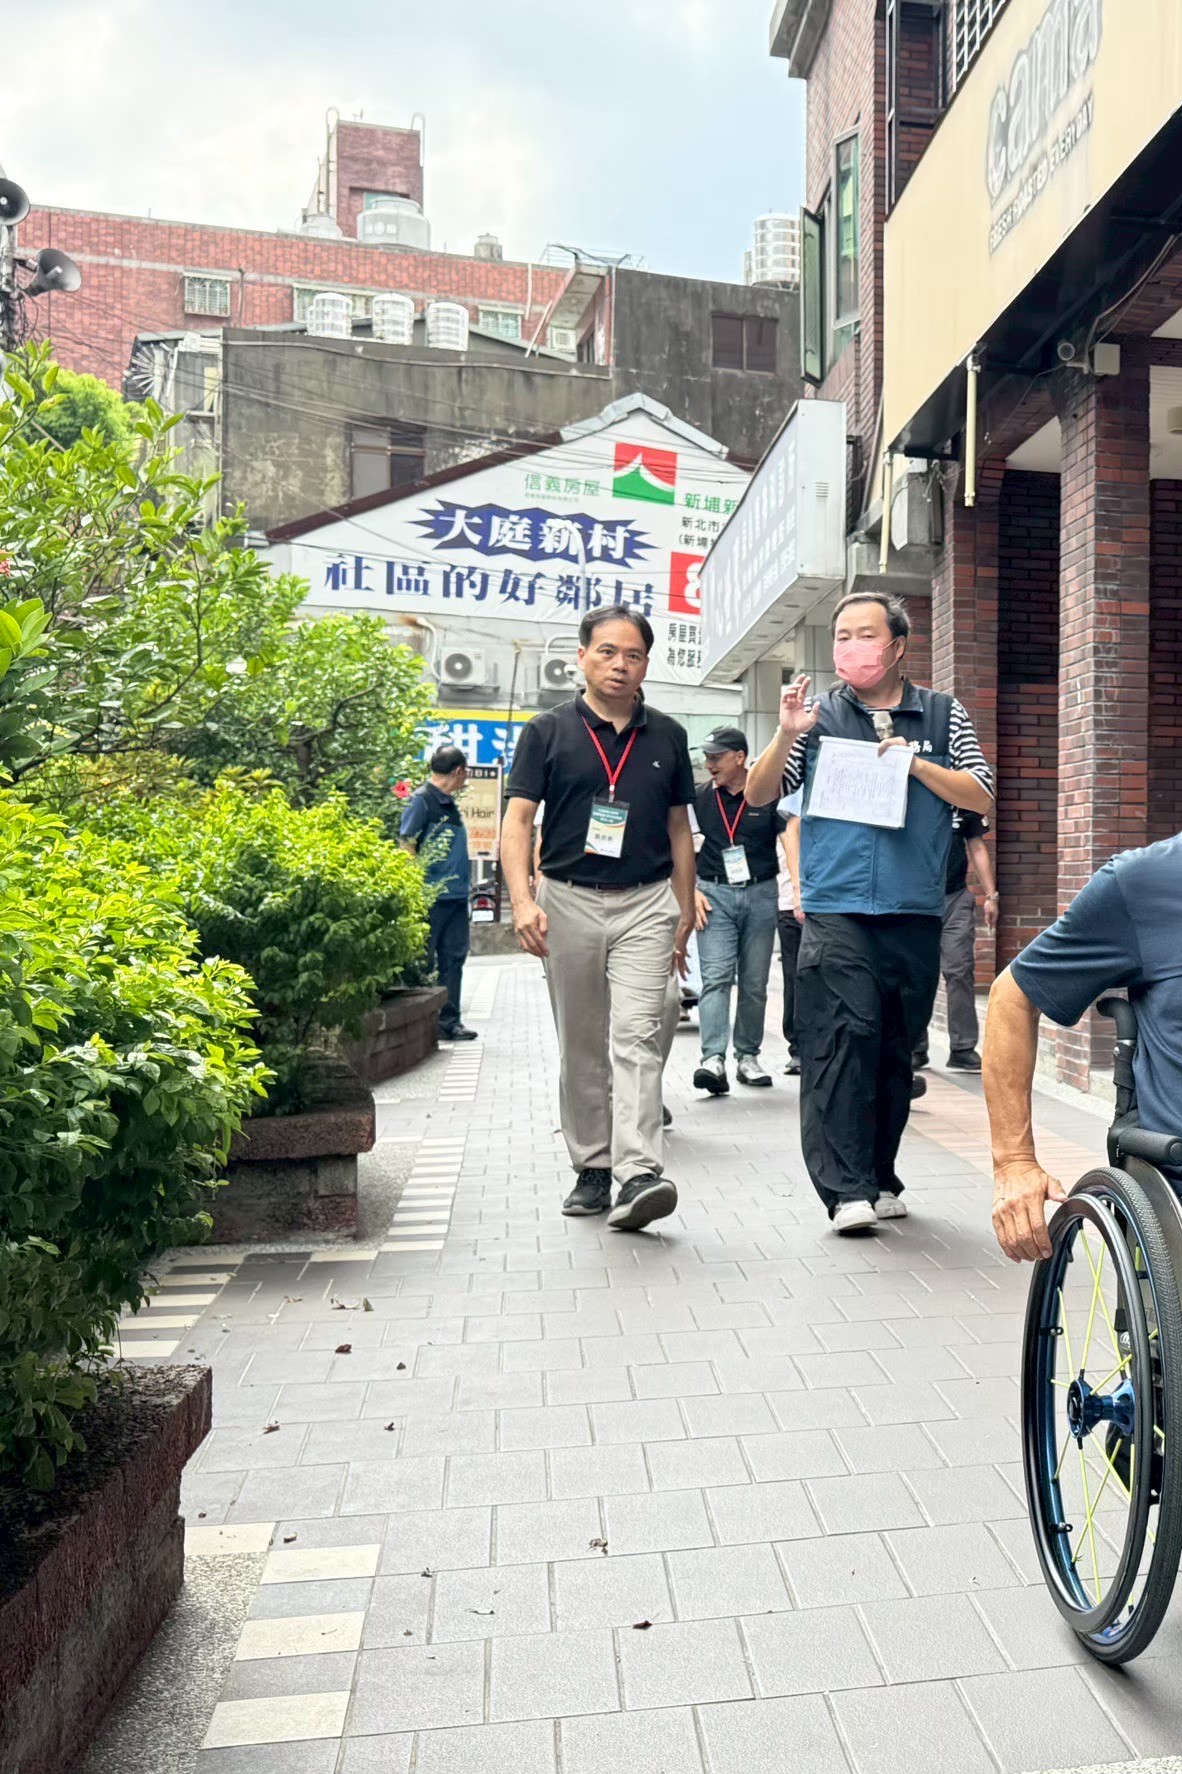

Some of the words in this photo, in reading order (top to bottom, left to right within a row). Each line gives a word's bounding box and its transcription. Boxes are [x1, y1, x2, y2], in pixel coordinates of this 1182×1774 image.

[525, 473, 601, 497] 信義房屋
[438, 509, 631, 560] 大庭新村
[681, 516, 727, 533] 新北市
[323, 553, 654, 618] 社區的好鄰居
[471, 808, 495, 818] Hair
